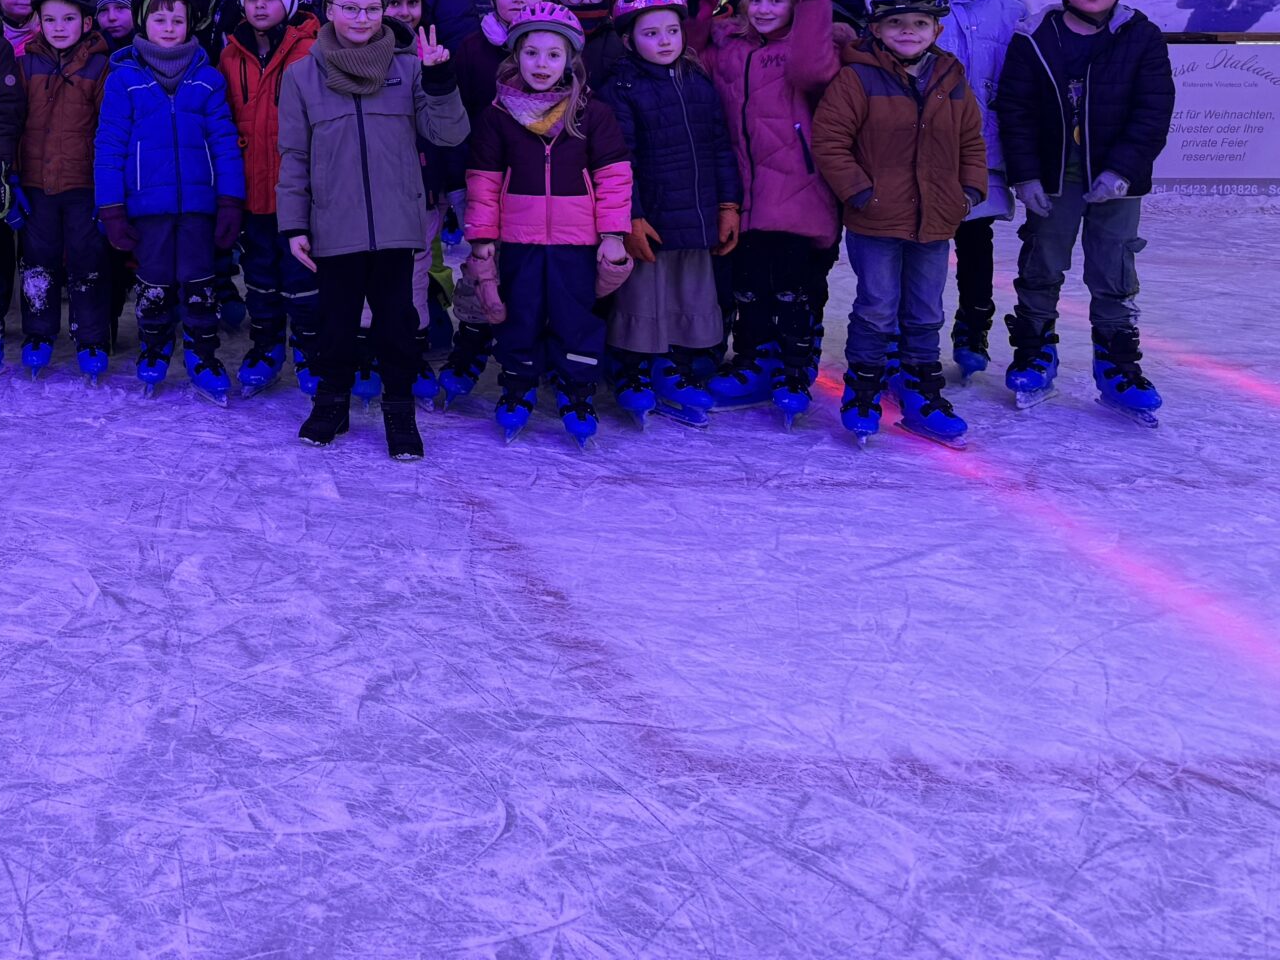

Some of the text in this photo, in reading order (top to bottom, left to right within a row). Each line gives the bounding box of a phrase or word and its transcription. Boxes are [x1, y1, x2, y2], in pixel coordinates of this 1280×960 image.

[1186, 109, 1201, 119] für
[1168, 123, 1264, 133] Silvester oder Ihre
[1180, 137, 1249, 149] private Feier
[1182, 152, 1246, 161] reservieren!
[1173, 184, 1207, 195] 05423
[1210, 184, 1259, 195] 4103826
